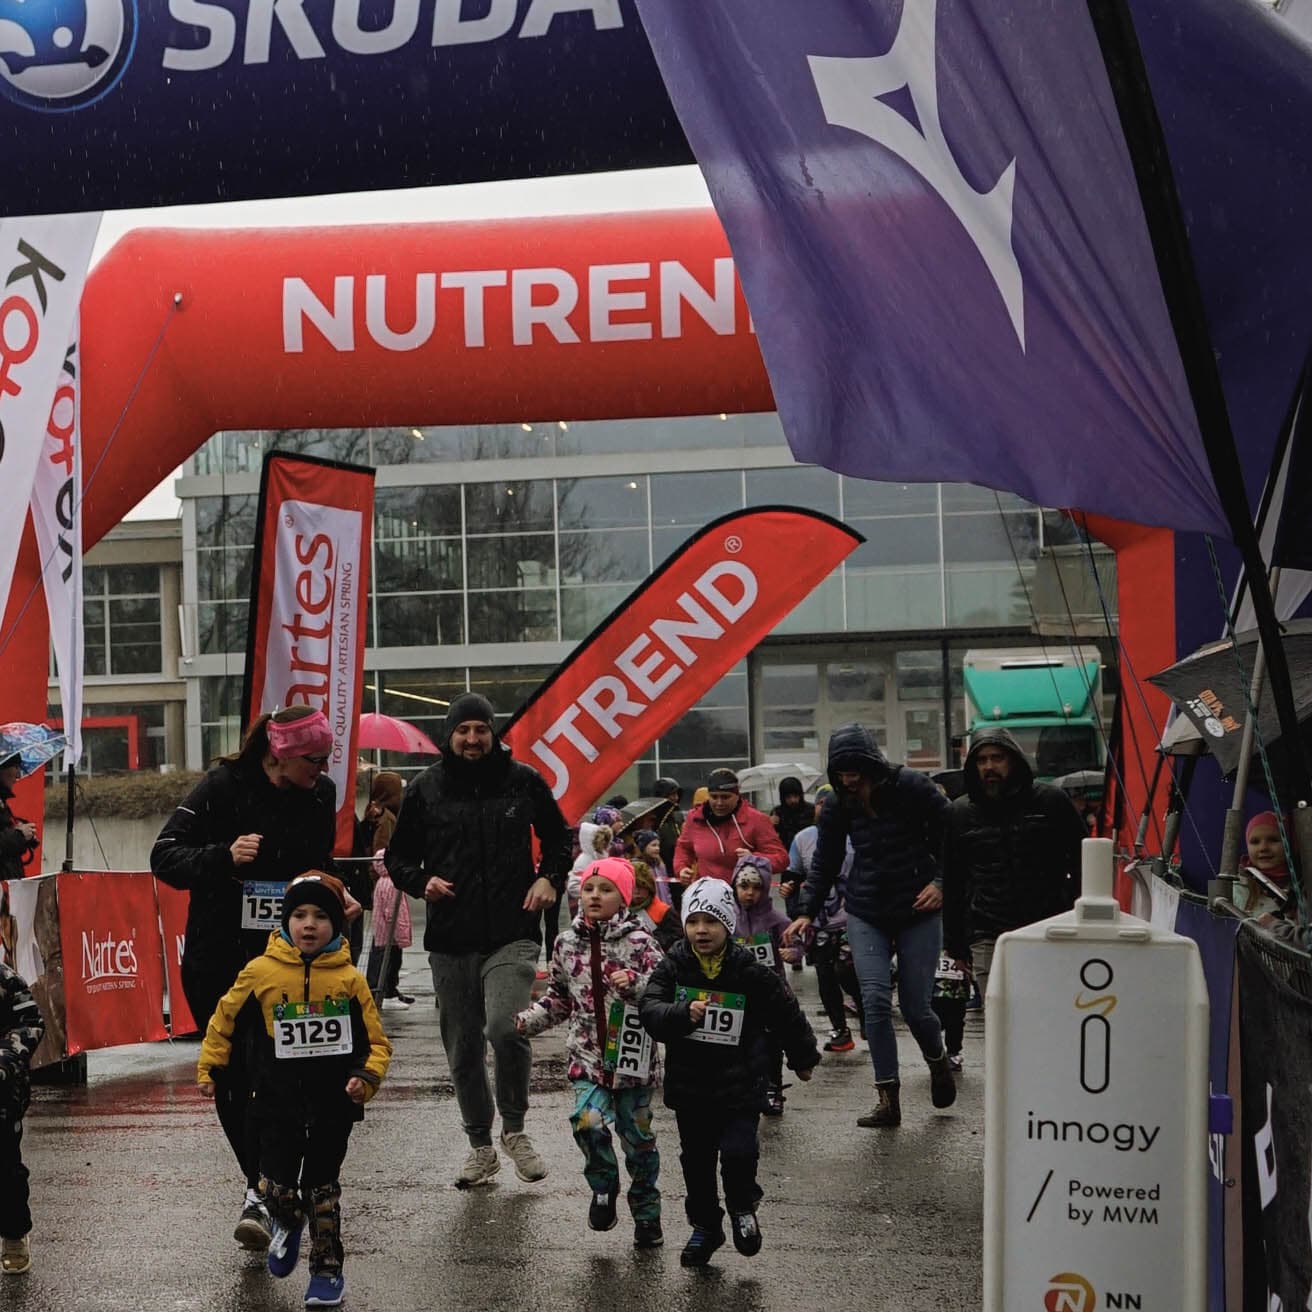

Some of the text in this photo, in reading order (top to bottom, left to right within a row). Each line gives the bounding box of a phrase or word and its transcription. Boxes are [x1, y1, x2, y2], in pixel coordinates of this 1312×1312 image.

[283, 258, 758, 353] NUTREN
[282, 532, 334, 715] artes
[333, 562, 354, 765] TOP QUALITY ARTESIAN SPRING
[530, 560, 758, 800] UTREND
[247, 898, 283, 920] 153
[82, 930, 137, 978] Nartes
[280, 1019, 342, 1045] 3129
[707, 1010, 733, 1032] 19
[1027, 1110, 1160, 1152] innogy
[1068, 1179, 1160, 1202] Powered
[1068, 1202, 1159, 1225] by MVM
[1106, 1292, 1142, 1310] NN
